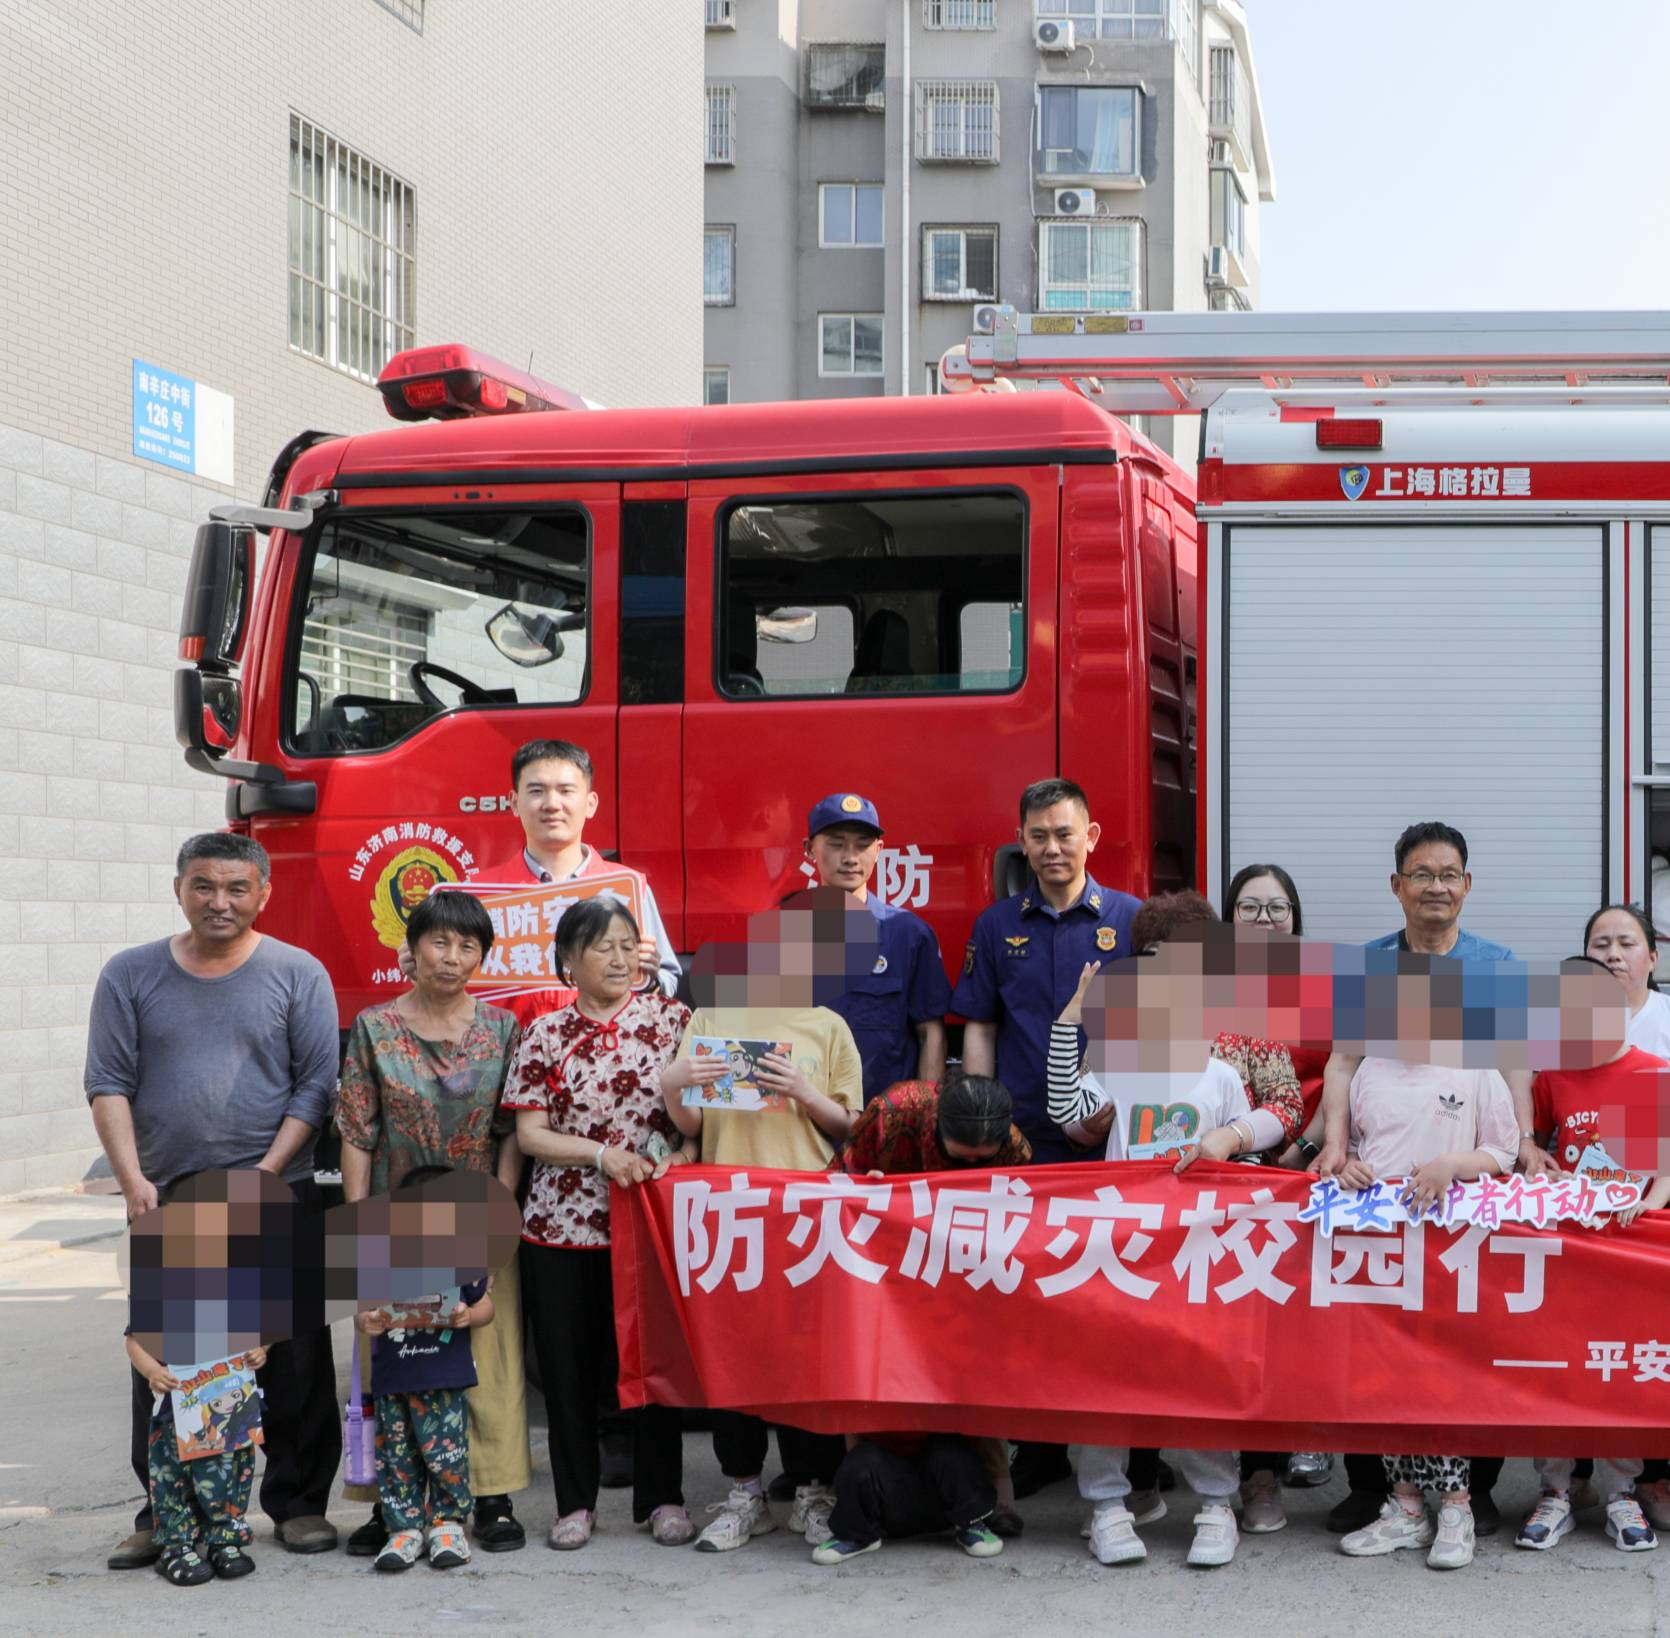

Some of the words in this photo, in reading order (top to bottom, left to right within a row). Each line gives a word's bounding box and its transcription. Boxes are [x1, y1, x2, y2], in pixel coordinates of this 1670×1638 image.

[138, 371, 191, 409] 南辛庄中街
[146, 401, 168, 429] 126
[171, 411, 184, 433] 号
[1375, 467, 1532, 497] 上海格拉曼
[800, 844, 934, 908] 防
[672, 1172, 1563, 1314] 防灾减灾校园行
